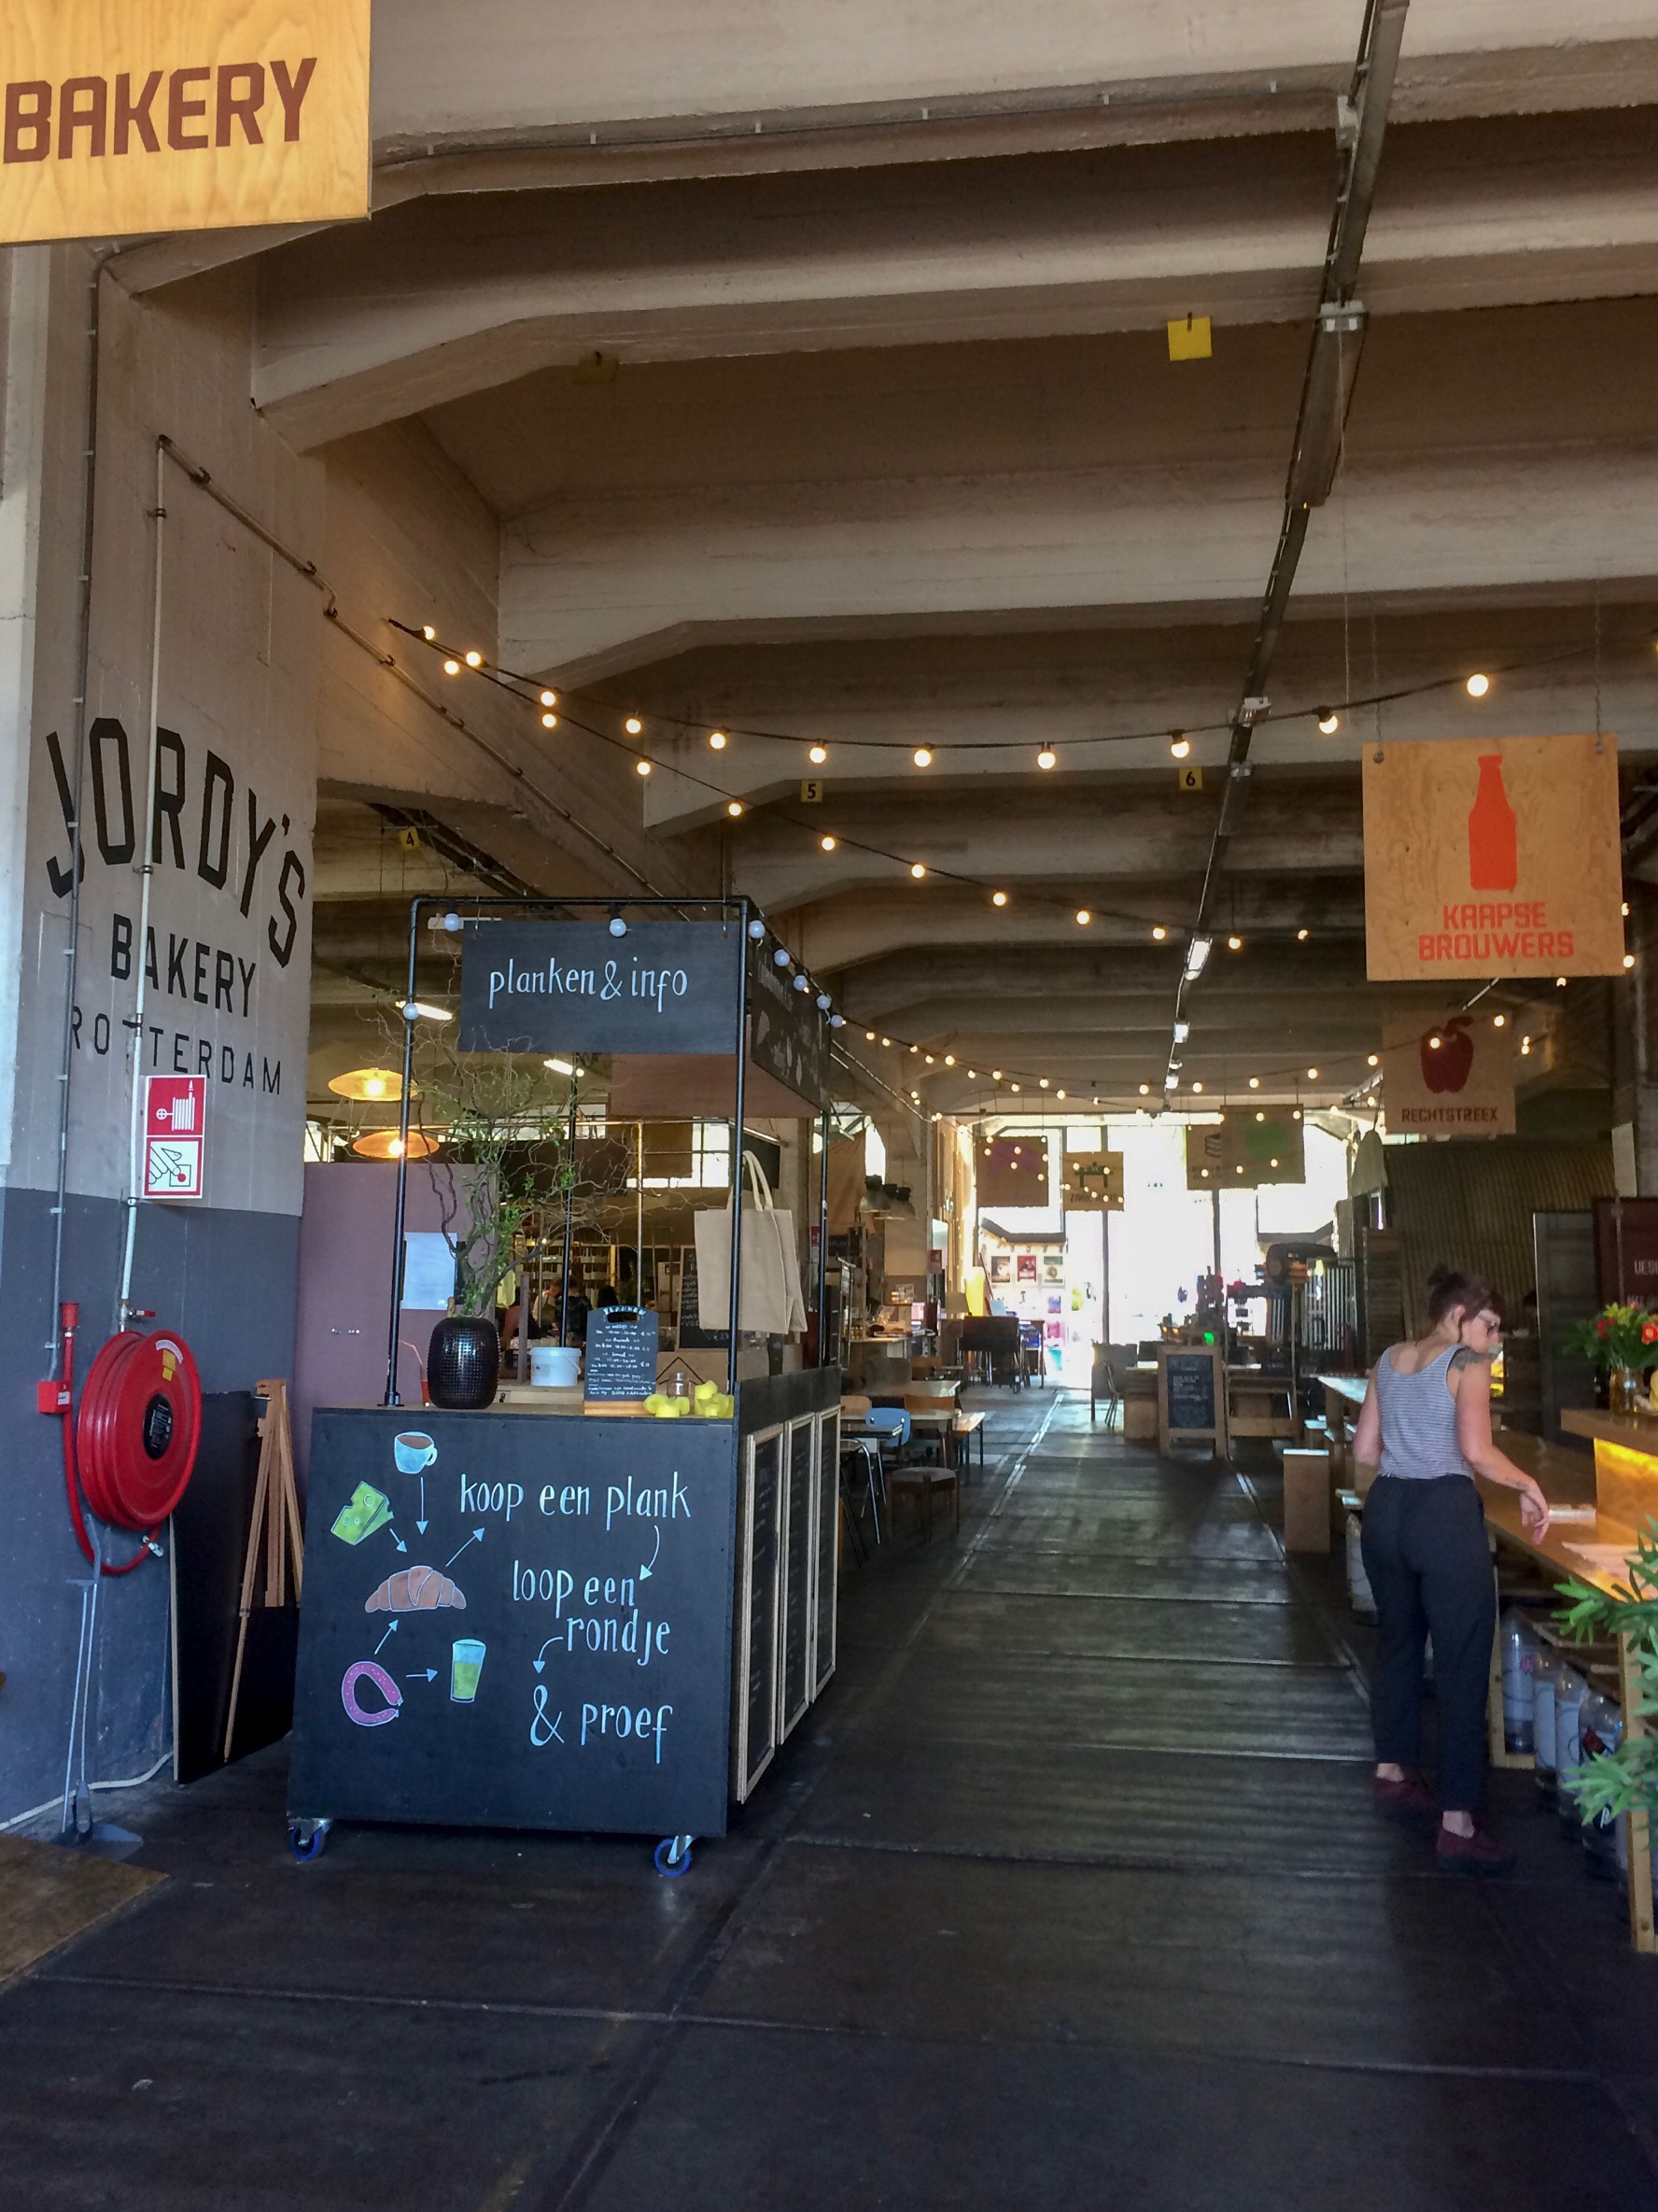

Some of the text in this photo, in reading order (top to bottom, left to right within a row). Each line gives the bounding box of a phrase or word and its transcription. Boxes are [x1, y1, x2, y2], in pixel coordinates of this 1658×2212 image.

[3, 57, 318, 164] BAKERY
[807, 783, 817, 799] 5
[1186, 770, 1196, 786] 6
[45, 717, 305, 968] JORDY'S
[1442, 902, 1547, 931] KAAPSE
[110, 913, 256, 1019] BAKERY
[1418, 931, 1575, 962] BROUWERS
[488, 957, 596, 1009] planken
[630, 956, 689, 1014] info
[460, 1471, 692, 1531] koop een plank
[513, 1559, 636, 1619] loop een
[566, 1608, 671, 1667] rondje
[529, 1684, 674, 1765] & proef
